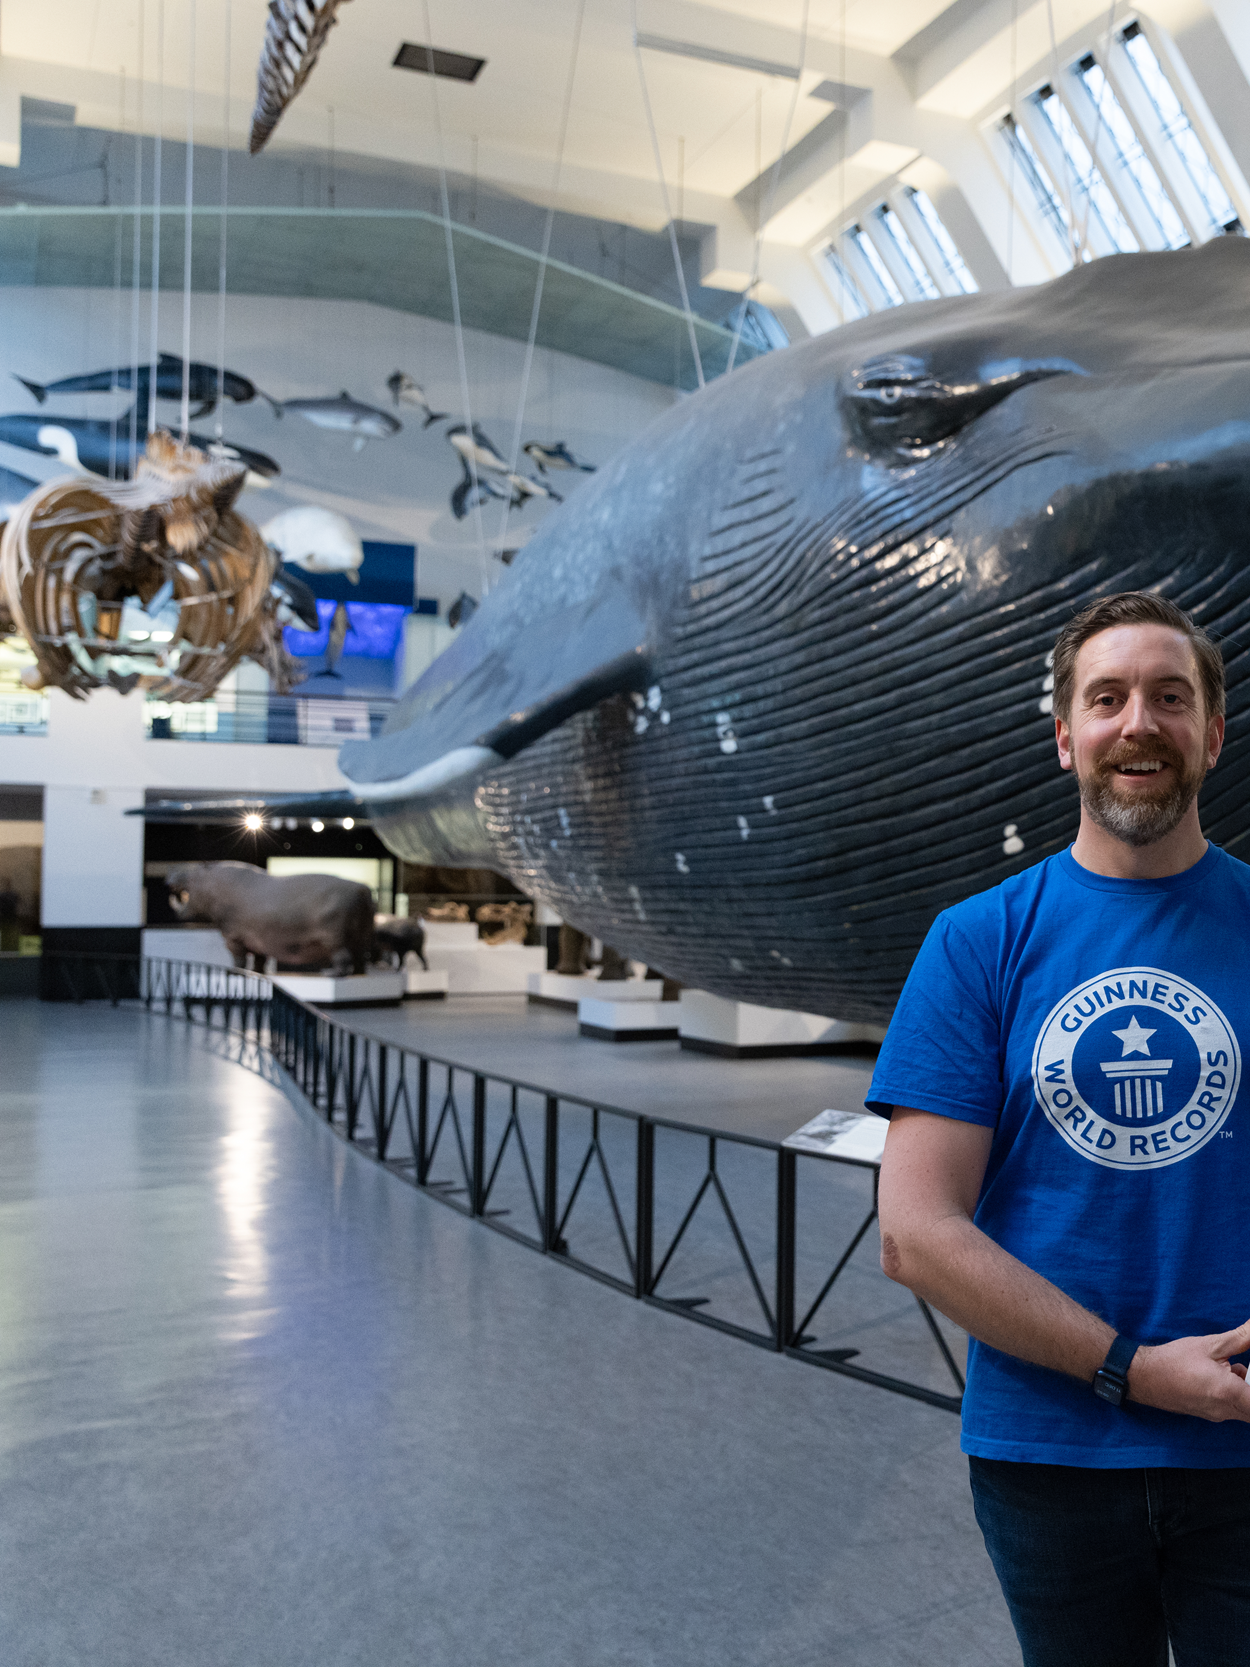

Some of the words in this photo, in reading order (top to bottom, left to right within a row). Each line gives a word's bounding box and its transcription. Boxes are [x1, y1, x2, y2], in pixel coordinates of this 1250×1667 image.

[1060, 979, 1208, 1033] GUINNESS
[1044, 1058, 1117, 1150] WORLD
[1129, 1050, 1228, 1156] RECORDS
[1219, 1131, 1233, 1139] TM
